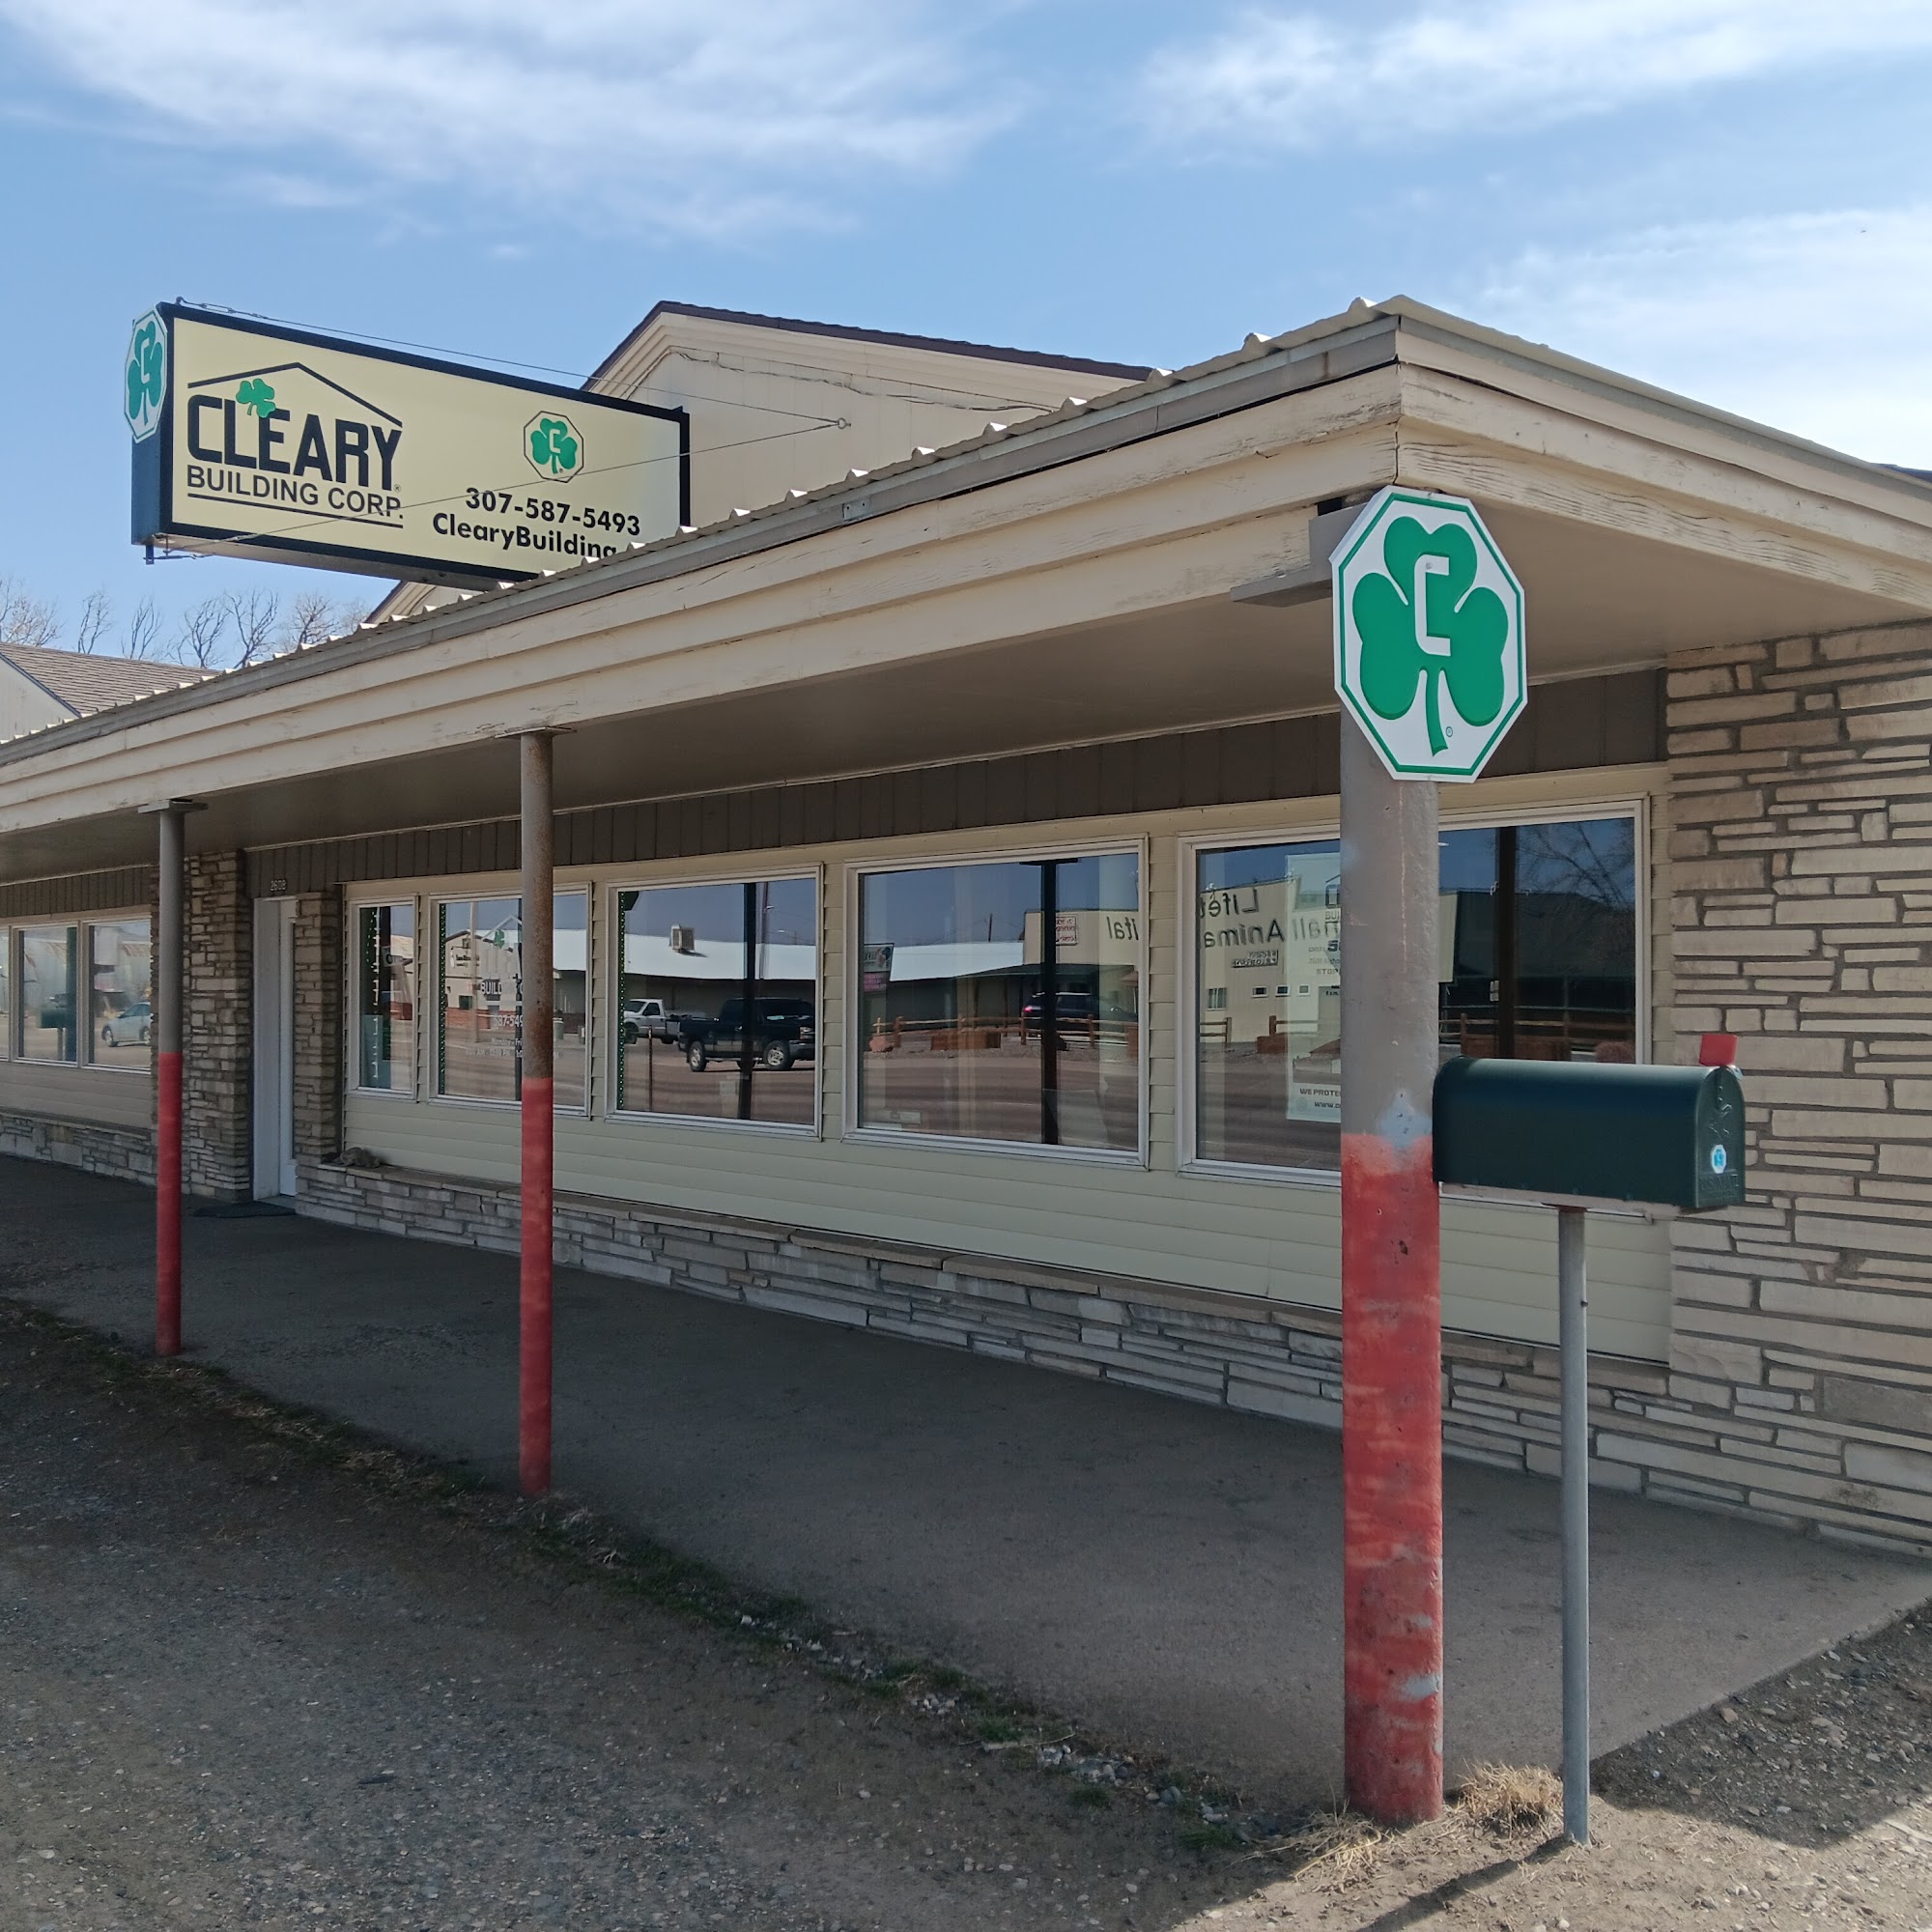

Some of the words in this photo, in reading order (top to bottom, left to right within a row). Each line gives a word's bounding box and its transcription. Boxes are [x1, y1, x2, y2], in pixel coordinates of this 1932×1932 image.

[186, 394, 403, 492] CLEARY
[186, 464, 320, 506] BUILDING
[327, 486, 404, 520] CORP.
[465, 487, 641, 536] 307-587-5493
[1313, 1089, 1341, 1097] PROTE
